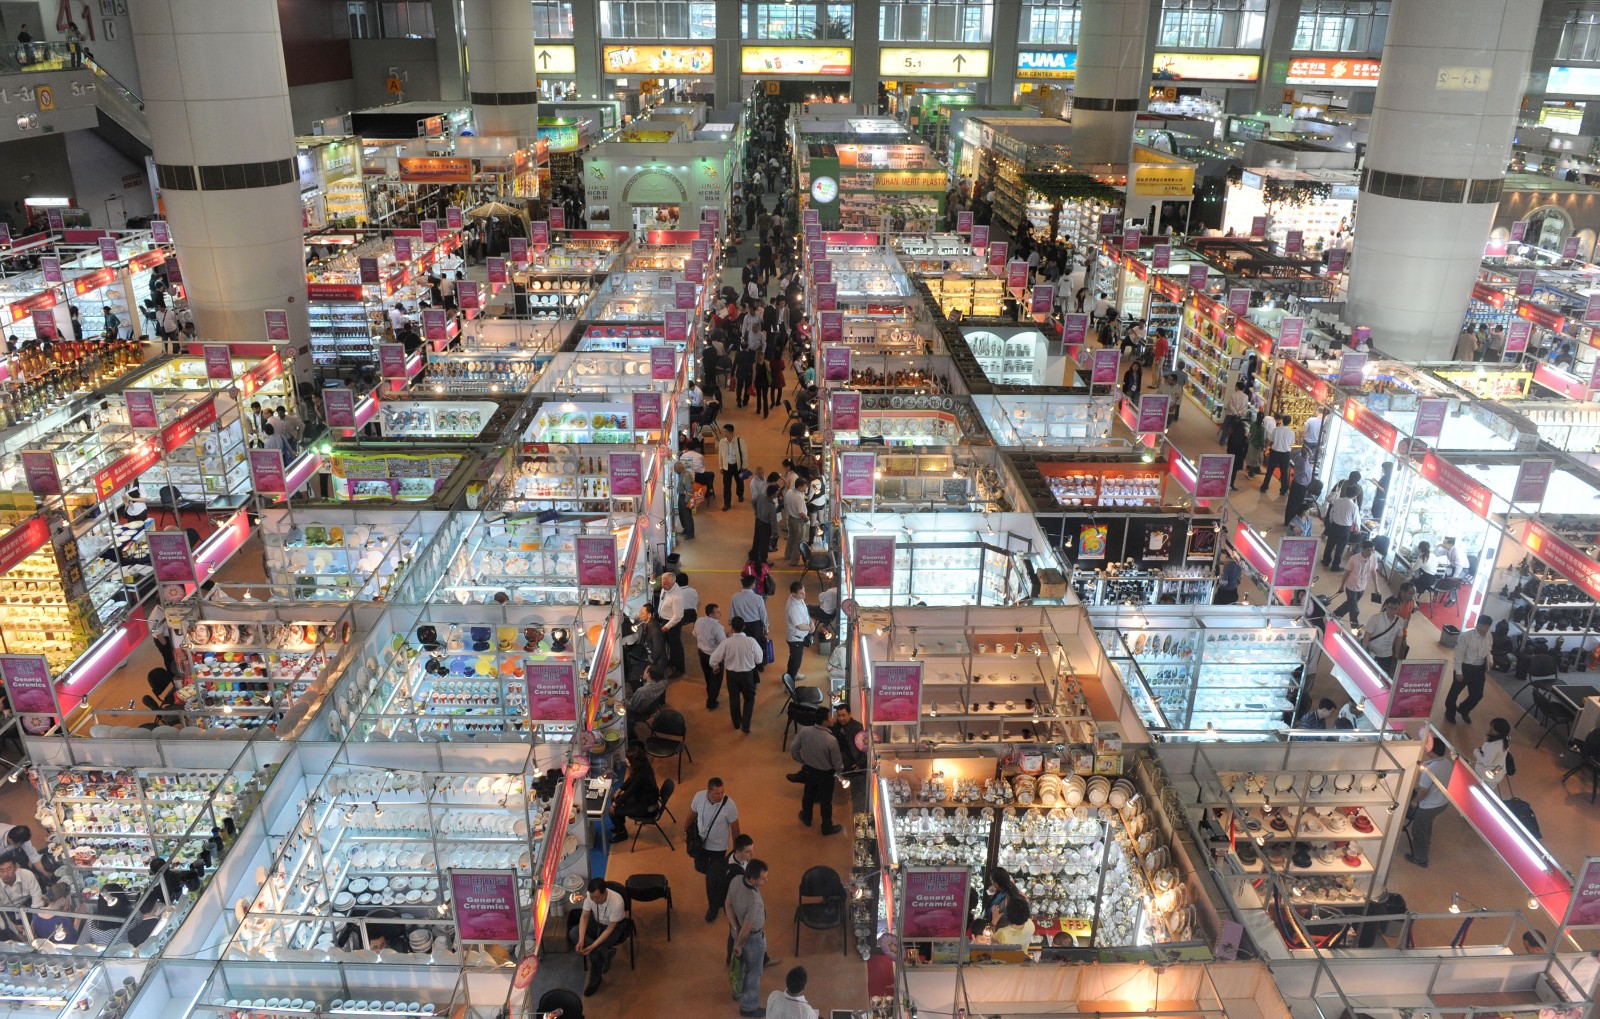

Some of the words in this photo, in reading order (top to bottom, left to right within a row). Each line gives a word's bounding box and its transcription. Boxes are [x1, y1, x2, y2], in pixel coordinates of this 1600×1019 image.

[1018, 52, 1066, 68] PUMA
[390, 81, 398, 90] A
[642, 82, 650, 92] C
[769, 83, 777, 93] D
[906, 85, 912, 94] E
[1040, 87, 1047, 95] F
[1166, 88, 1174, 97] G
[1284, 91, 1293, 100] H
[875, 177, 898, 185] WUHAN
